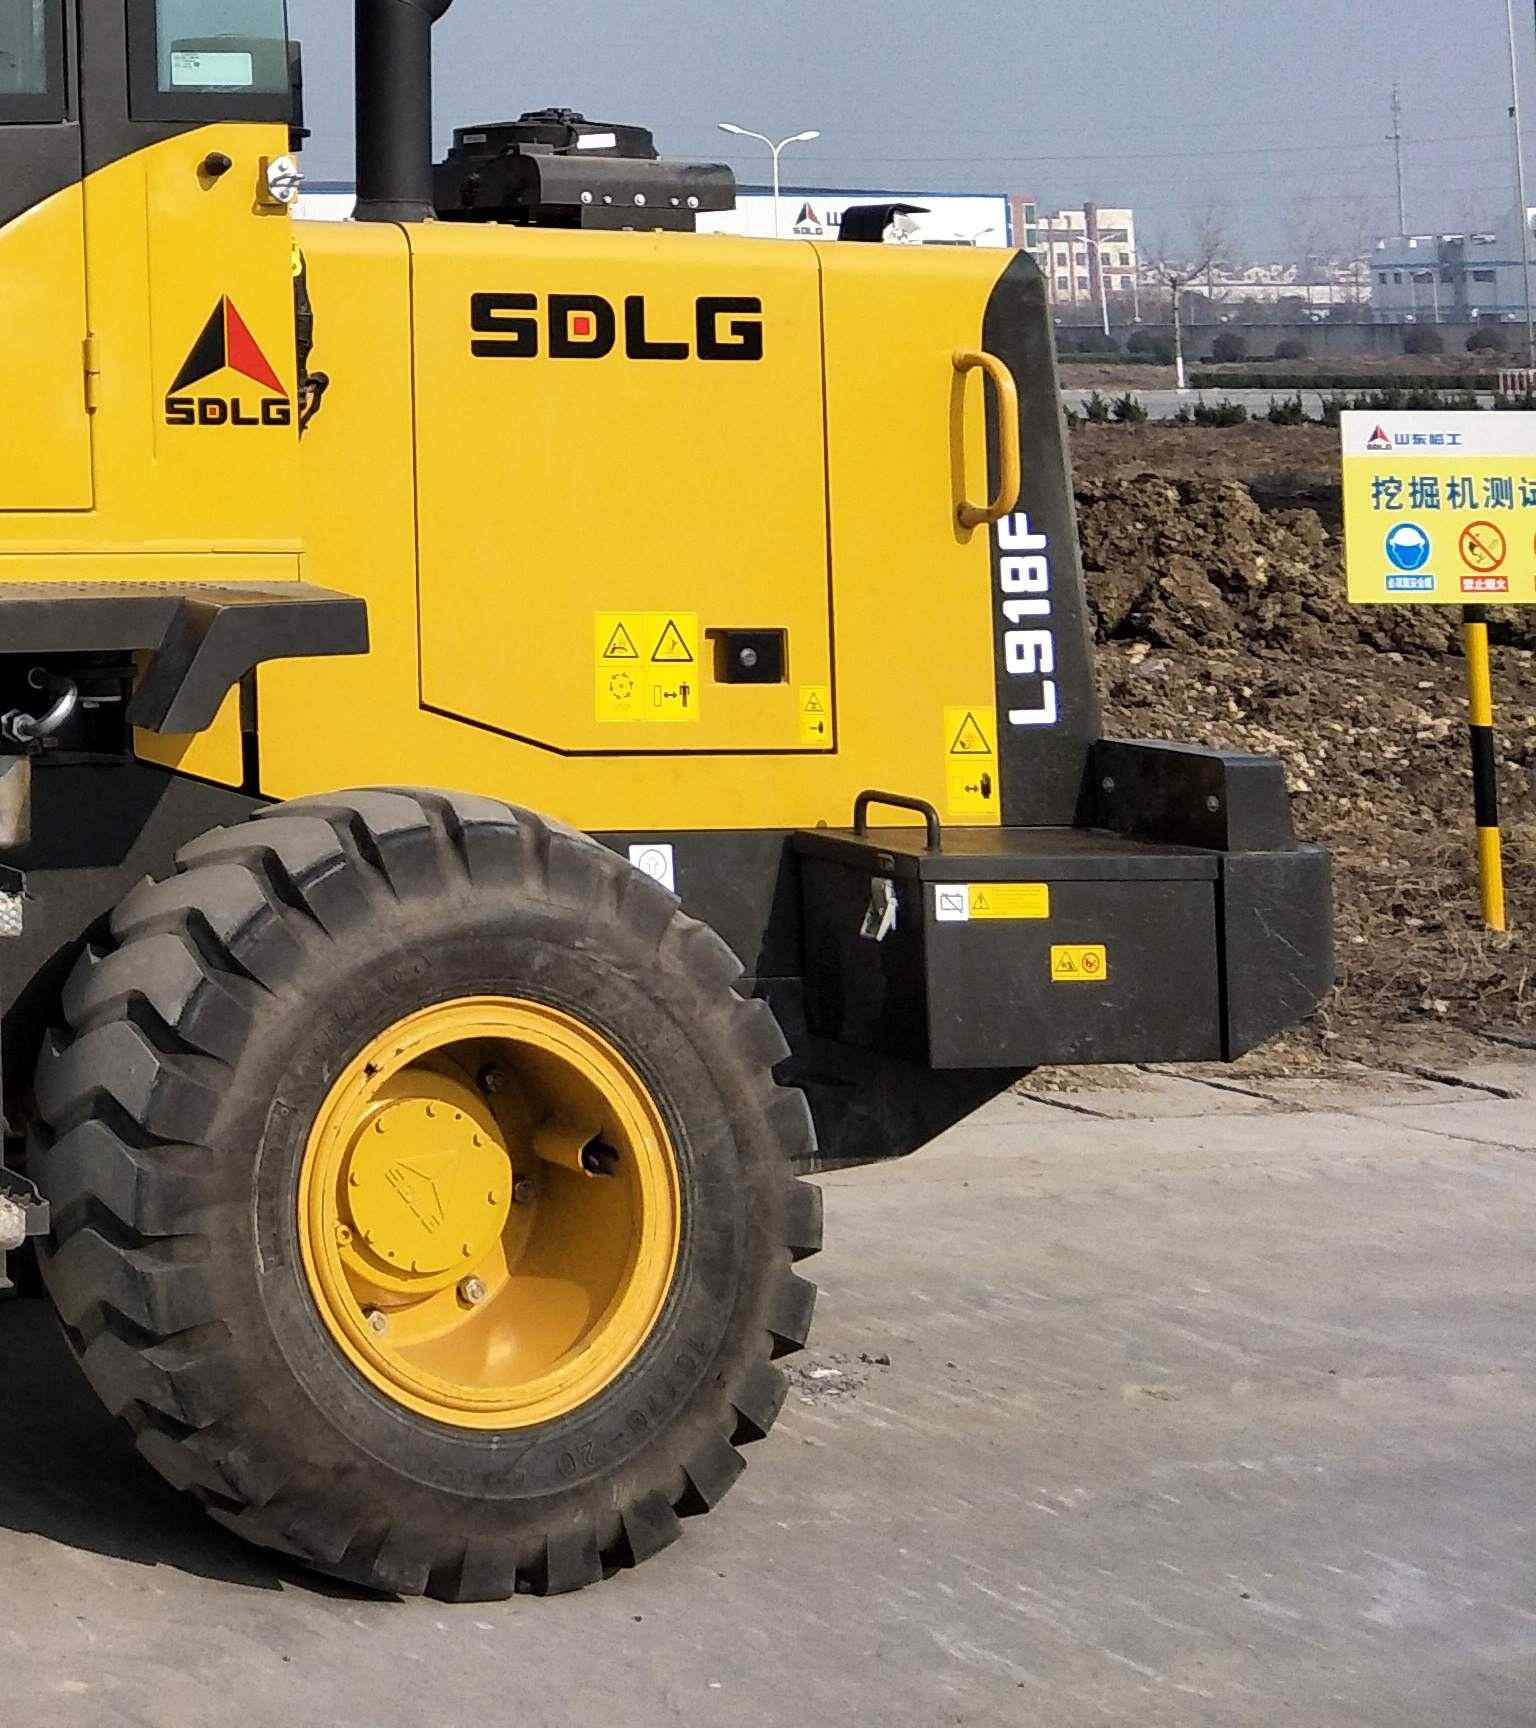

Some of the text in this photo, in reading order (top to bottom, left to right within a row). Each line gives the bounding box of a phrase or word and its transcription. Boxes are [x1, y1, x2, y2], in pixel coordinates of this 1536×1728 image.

[470, 292, 764, 361] SDLG
[165, 397, 291, 426] SDLG
[997, 512, 1058, 725] L918F
